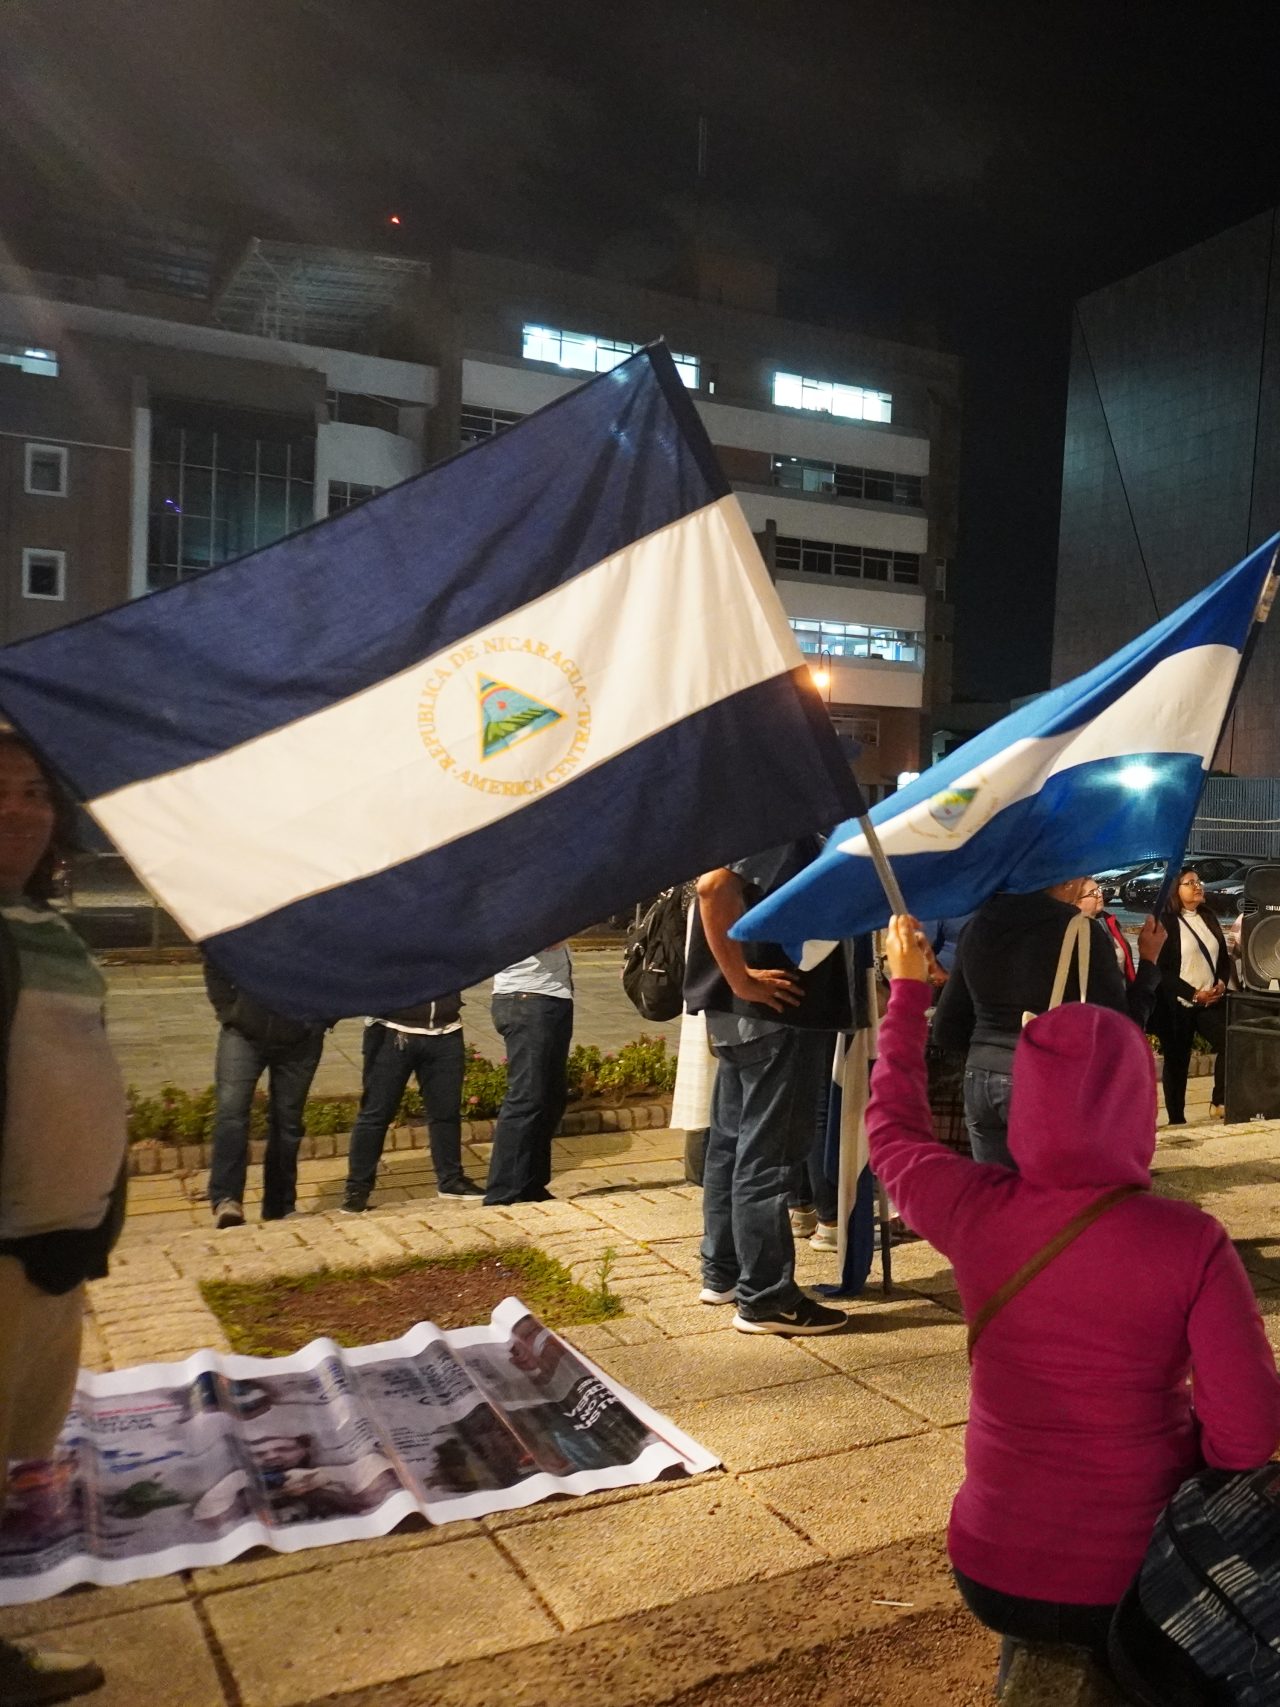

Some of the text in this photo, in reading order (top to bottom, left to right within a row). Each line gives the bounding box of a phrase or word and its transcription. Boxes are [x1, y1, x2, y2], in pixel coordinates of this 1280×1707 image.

[418, 637, 586, 771] REPUBLICA DE NICARAGUA
[457, 705, 591, 796] AMERICA CENTRAL
